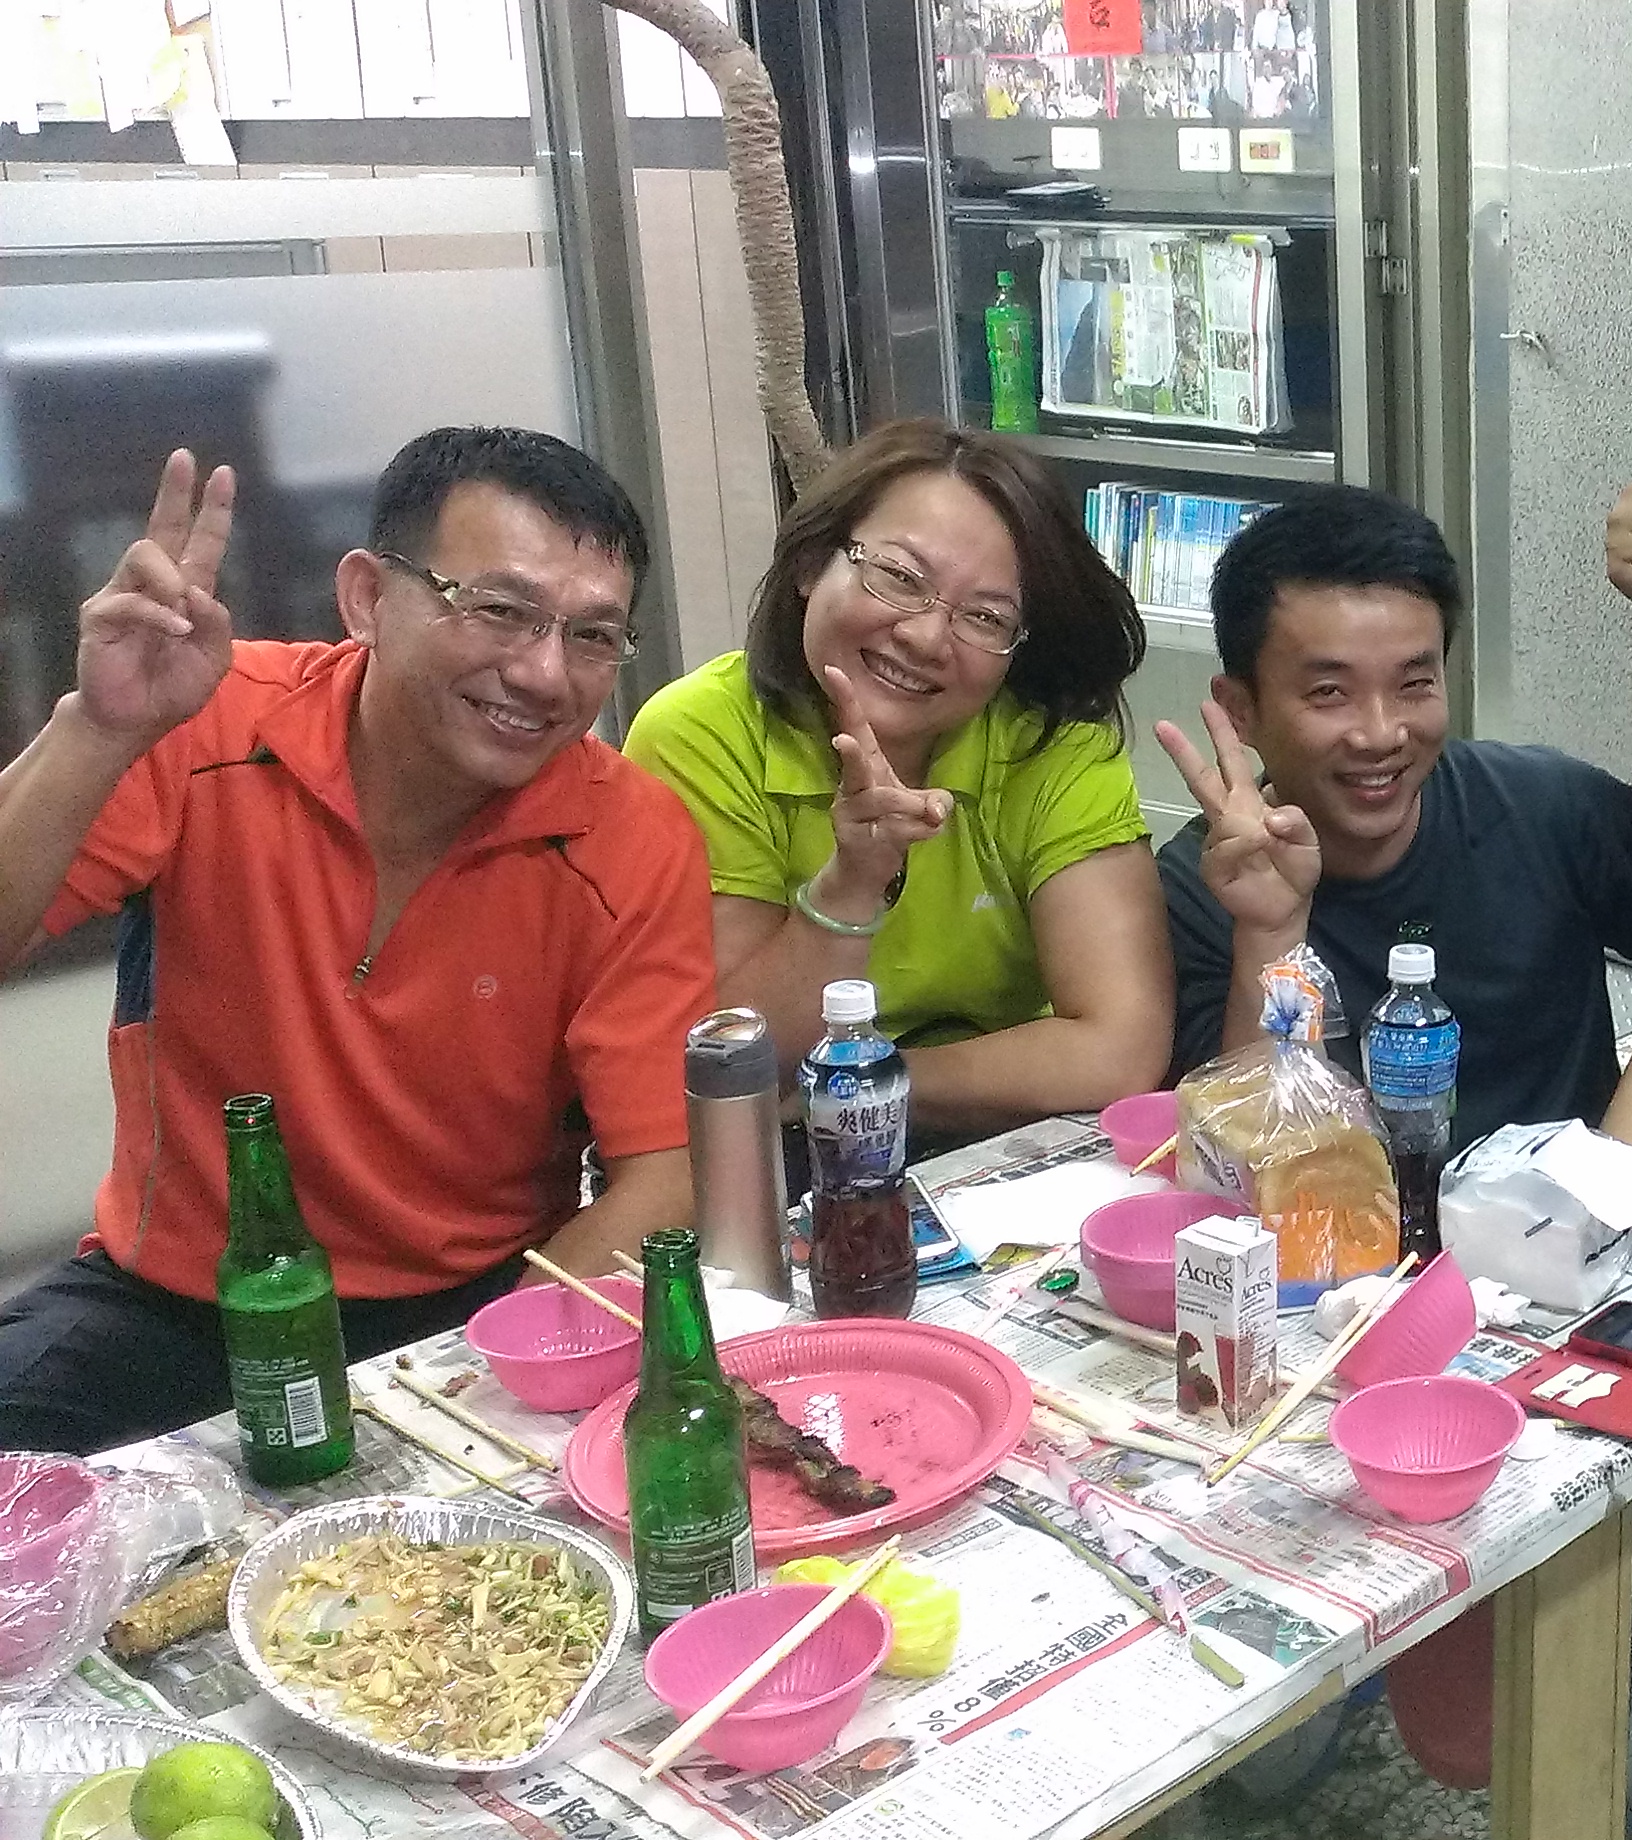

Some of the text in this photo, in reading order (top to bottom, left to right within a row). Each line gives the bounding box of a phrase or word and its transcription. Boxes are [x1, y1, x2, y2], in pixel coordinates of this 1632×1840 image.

[837, 1098, 906, 1134] 爽健美
[1177, 1256, 1233, 1294] Acres
[1241, 1280, 1272, 1300] Acres
